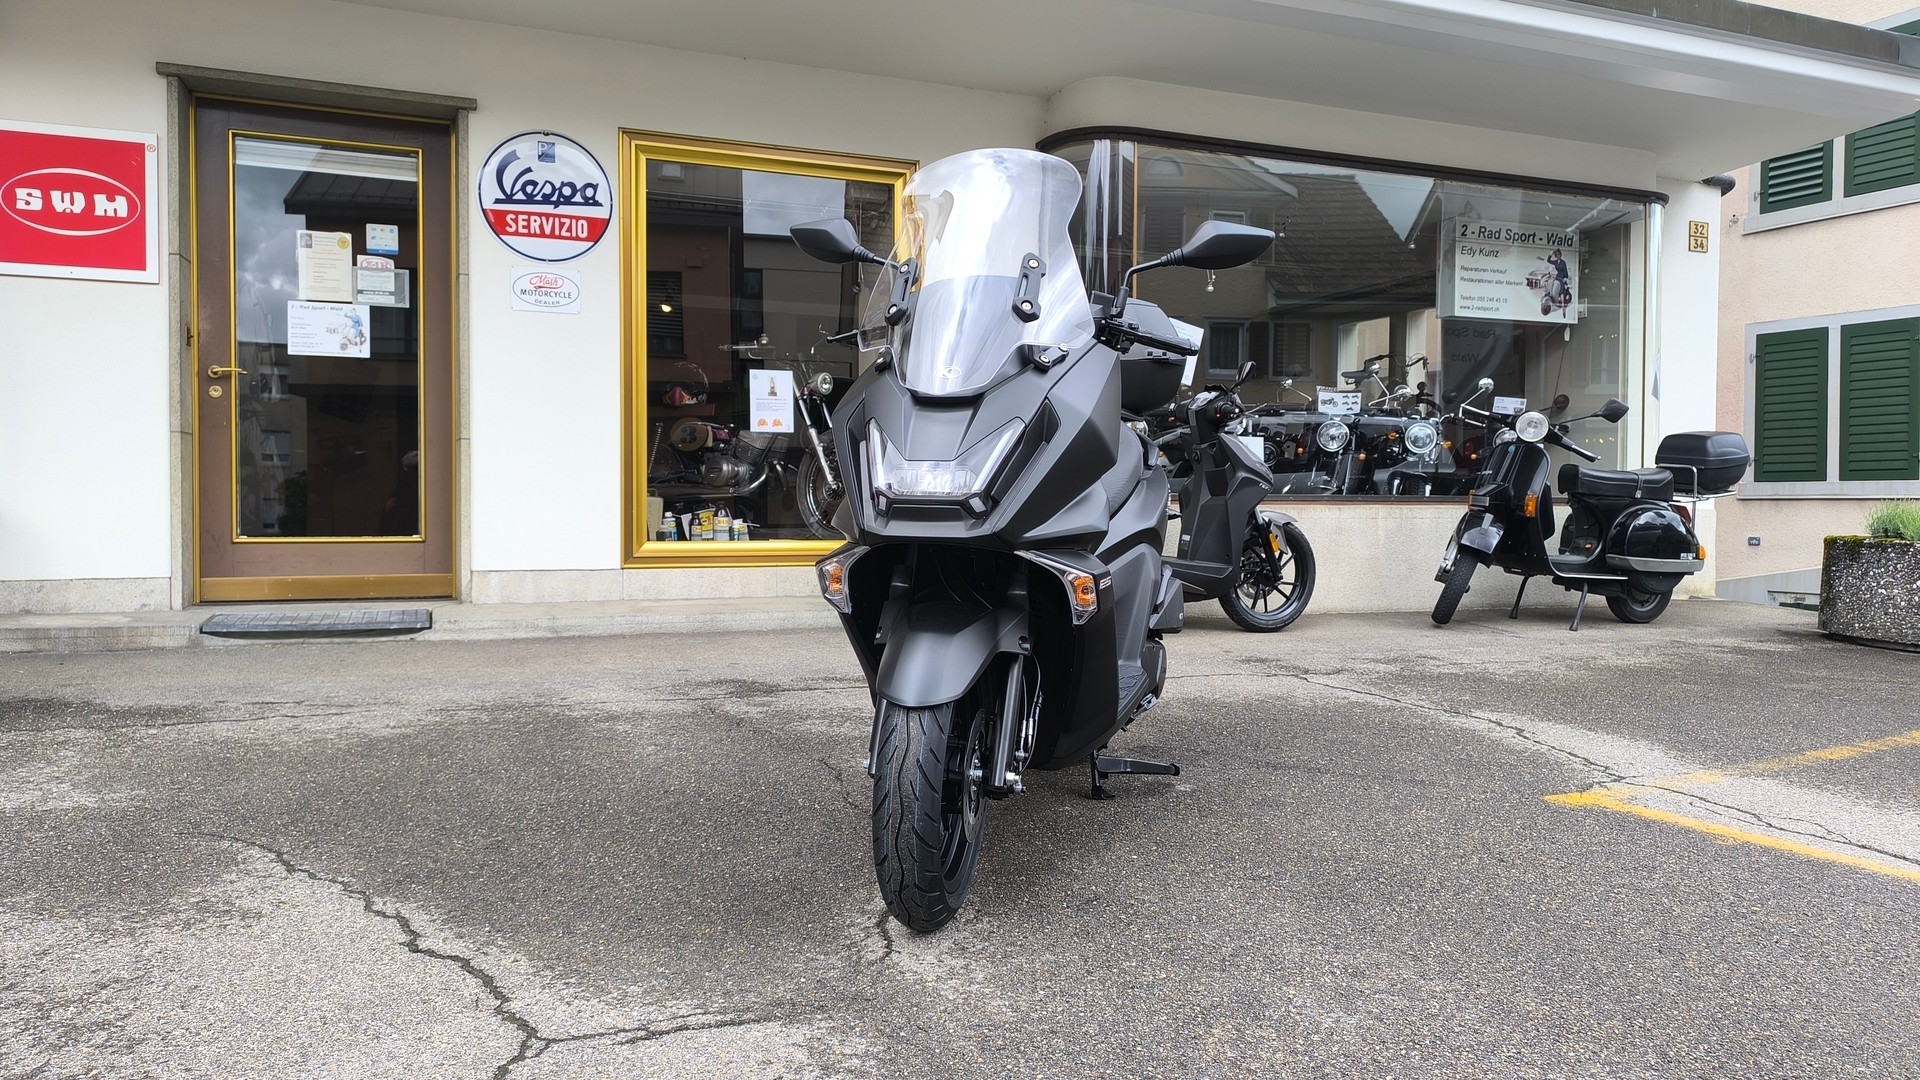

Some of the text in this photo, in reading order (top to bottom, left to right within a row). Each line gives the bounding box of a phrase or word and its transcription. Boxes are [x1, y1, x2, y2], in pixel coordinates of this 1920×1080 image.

[492, 149, 604, 209] Vespa
[15, 187, 129, 218] SWM
[505, 213, 588, 238] SERVIZIO
[1693, 223, 1705, 235] 32
[1460, 224, 1468, 237] 2
[1478, 225, 1501, 240] Rad
[1505, 228, 1536, 245] Sport
[1546, 232, 1574, 247] Wald
[1693, 238, 1705, 250] 34
[1461, 245, 1499, 258] Edy Kunz
[529, 275, 564, 289] Mash
[520, 288, 572, 299] MOTORCYCLE
